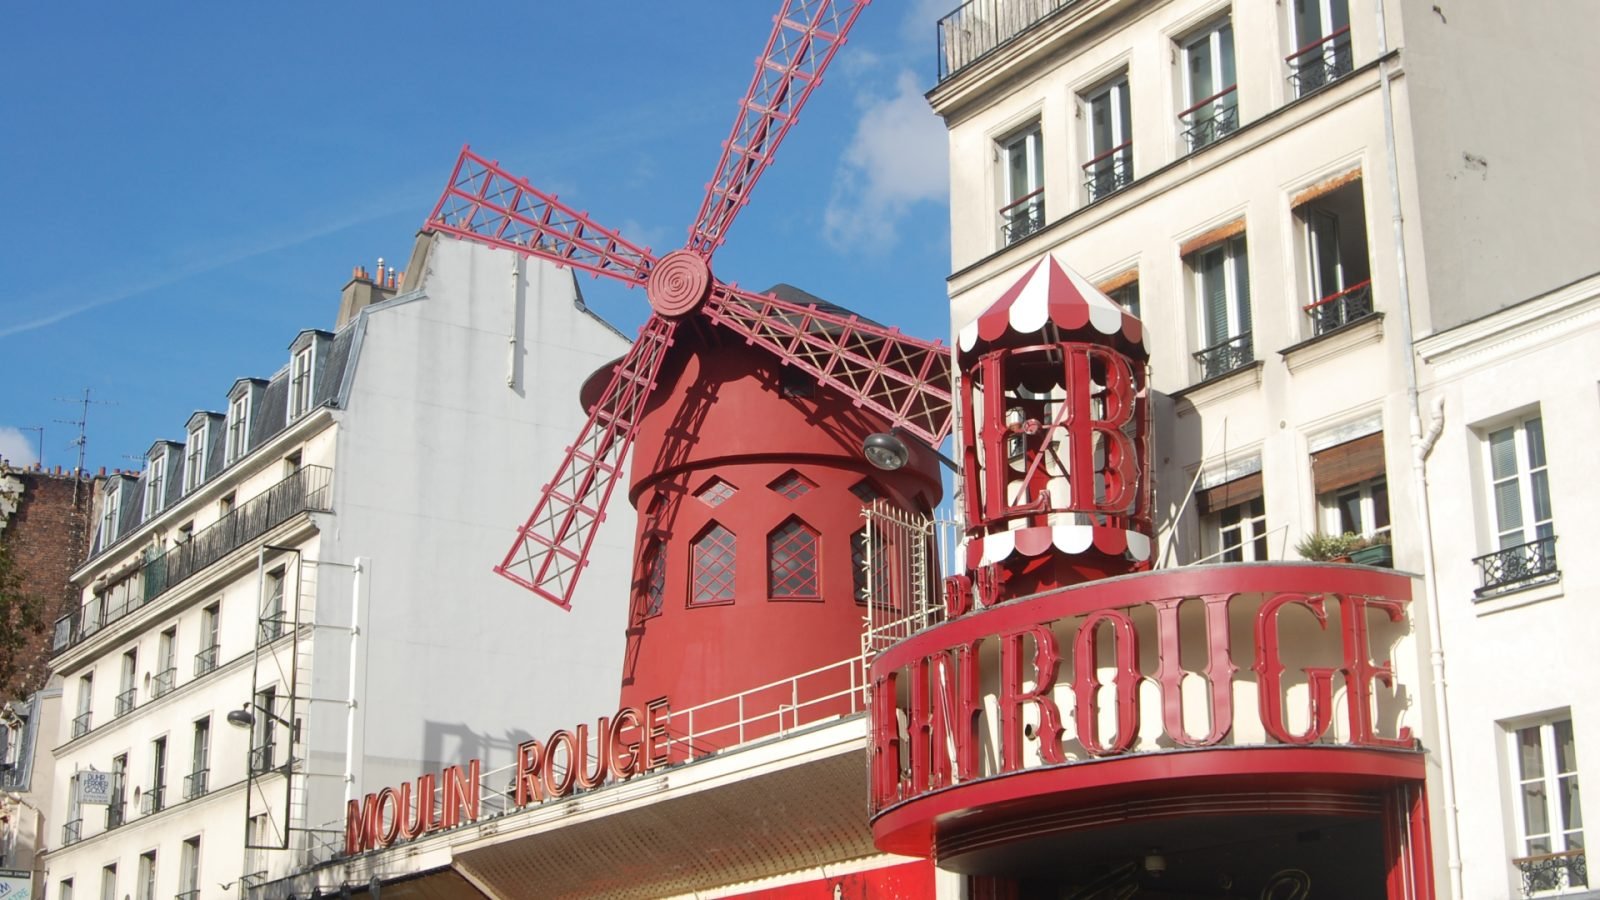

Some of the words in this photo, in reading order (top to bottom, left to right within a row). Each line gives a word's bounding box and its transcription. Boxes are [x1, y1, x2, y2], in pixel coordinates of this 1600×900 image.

[1000, 592, 1414, 771] ROUGE
[346, 758, 480, 857] MOULIN
[515, 696, 671, 809] ROUGE
